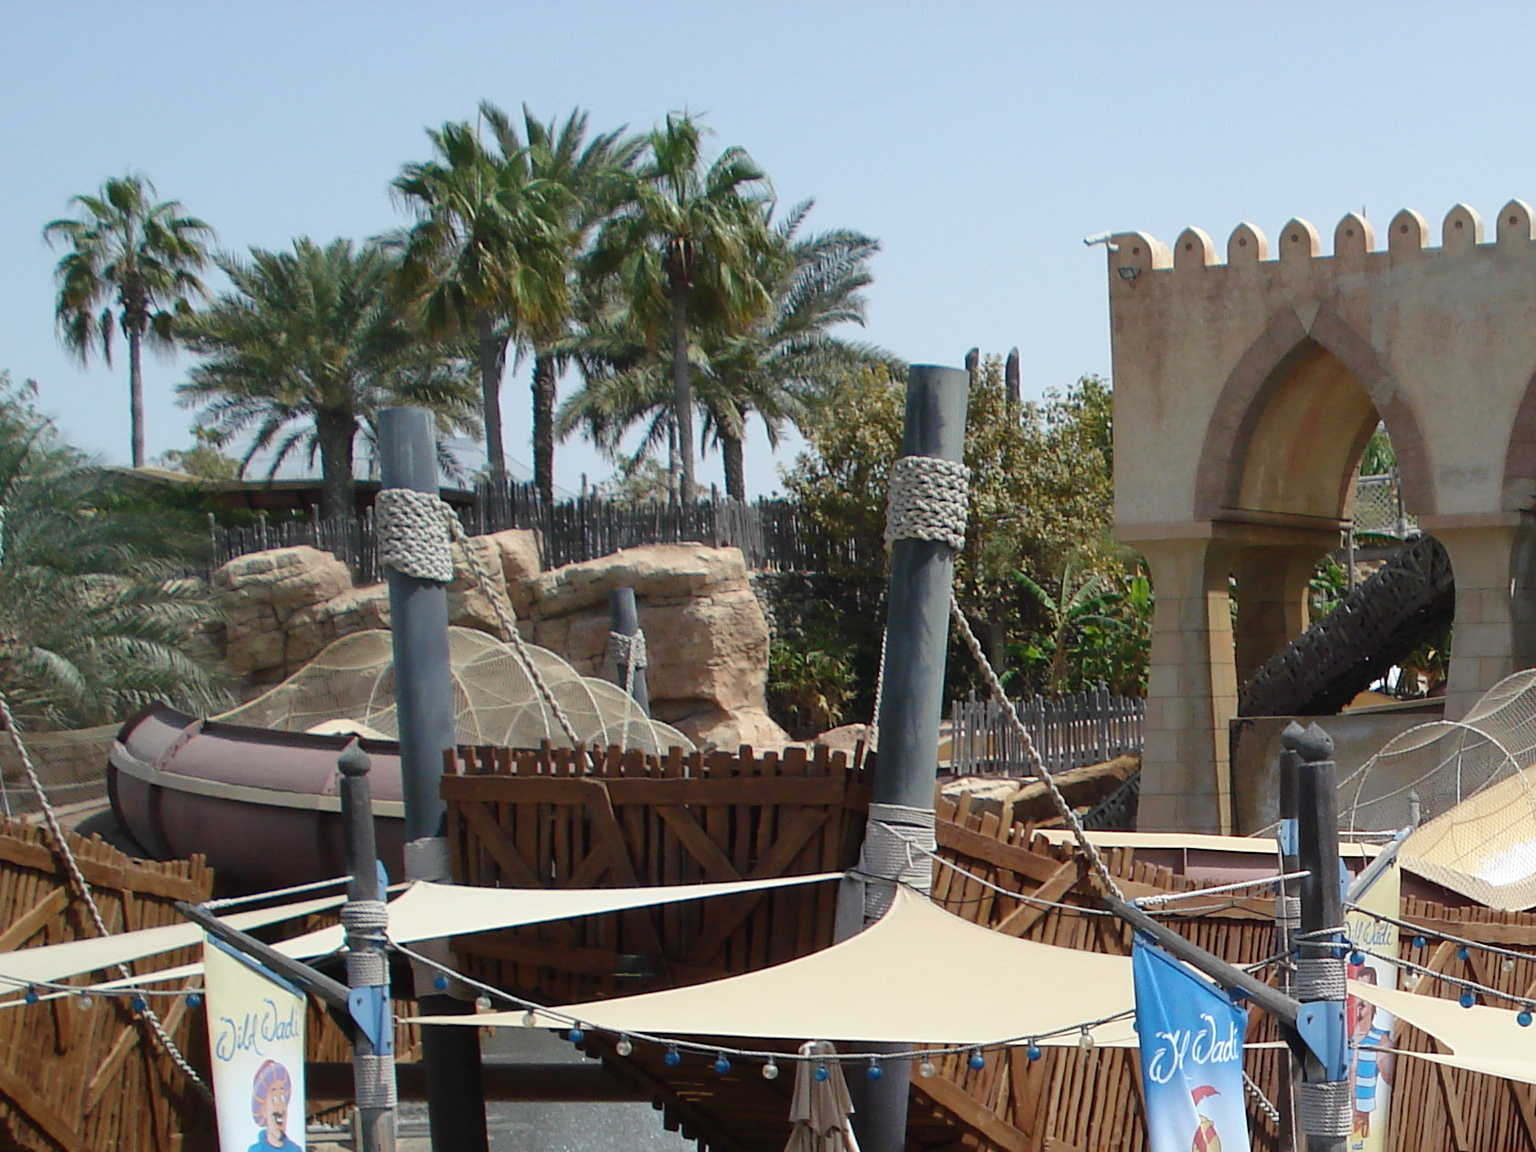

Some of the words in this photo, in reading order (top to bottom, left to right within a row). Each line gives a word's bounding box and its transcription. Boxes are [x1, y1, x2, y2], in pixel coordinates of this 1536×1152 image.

[215, 1016, 265, 1062] Wild
[261, 998, 300, 1042] Wadi
[1192, 1012, 1240, 1065] Wadi
